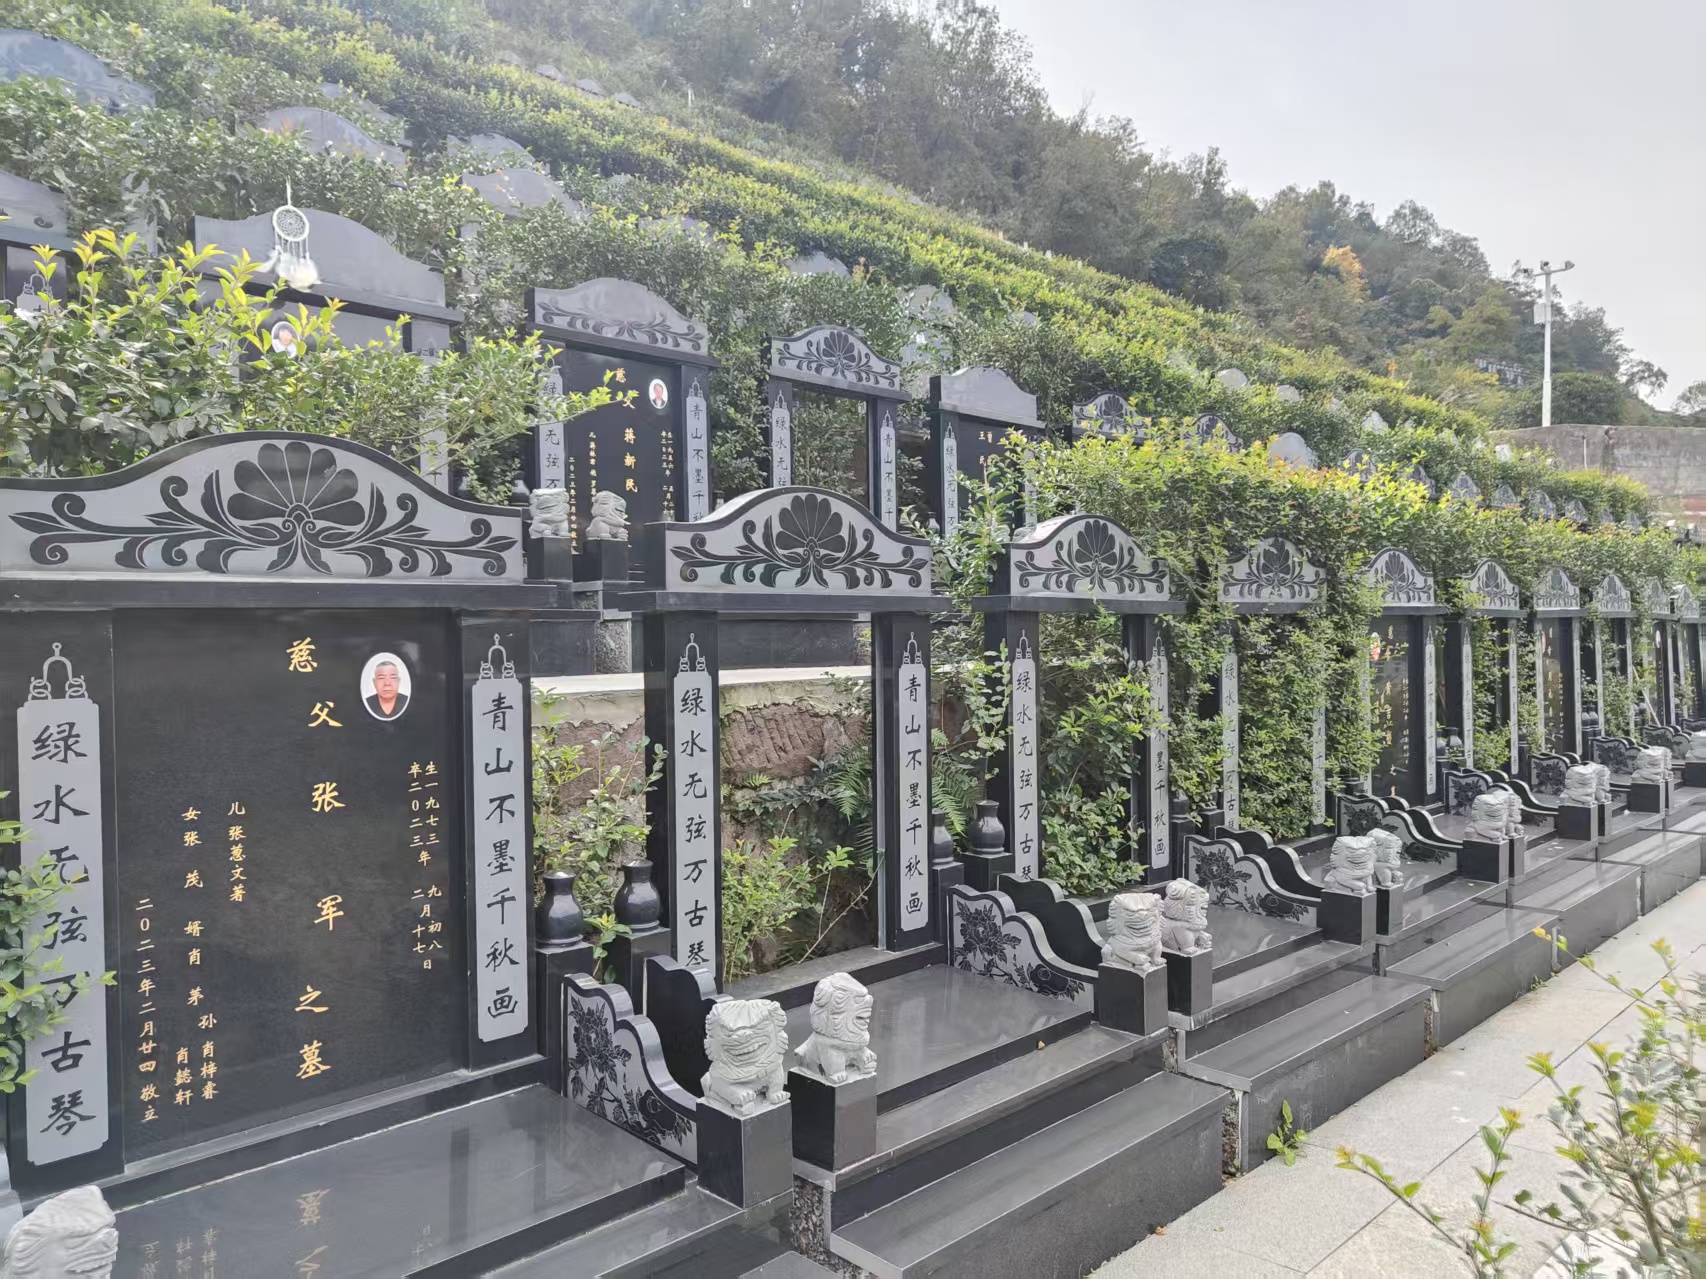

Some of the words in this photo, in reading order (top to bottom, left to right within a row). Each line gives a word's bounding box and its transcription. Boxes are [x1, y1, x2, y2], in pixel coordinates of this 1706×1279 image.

[482, 692, 520, 1019] 青山不墨千秋画
[679, 687, 710, 966] 绿水无弦万古琴
[904, 674, 924, 914] 青山不墨千秋画
[1016, 671, 1034, 880] 绿水无弦万古琴
